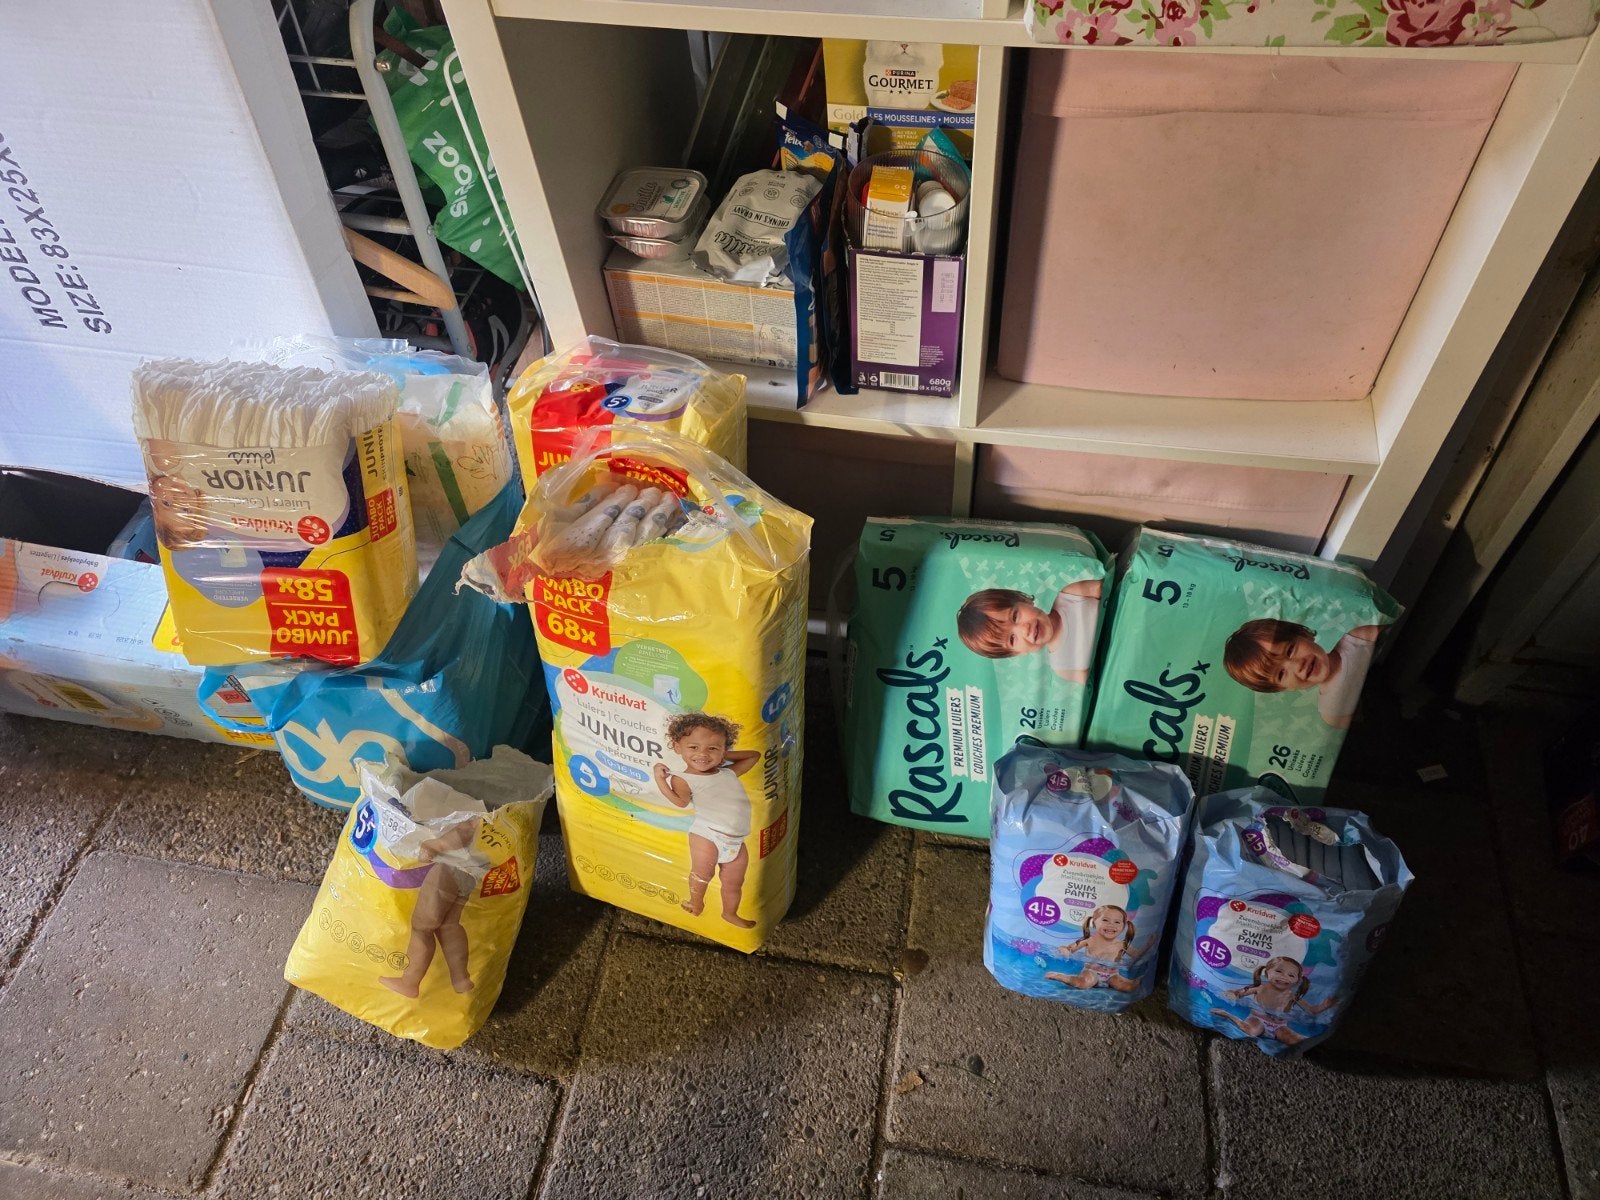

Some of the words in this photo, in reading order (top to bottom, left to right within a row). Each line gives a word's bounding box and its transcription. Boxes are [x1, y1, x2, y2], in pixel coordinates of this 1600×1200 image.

[868, 75, 933, 91] GOURMET
[833, 108, 864, 121] Gold
[885, 114, 936, 124] MOUSSELINES
[929, 378, 952, 387] 680g
[228, 447, 275, 470] plus
[201, 468, 312, 493] JUNIOR
[275, 498, 311, 510] Luiers
[376, 500, 386, 531] PACK
[231, 517, 294, 534] Kruidvat
[368, 498, 380, 539] JUMBO
[879, 529, 896, 542] 5
[943, 530, 1021, 549] Rascals
[1157, 544, 1174, 558] 5
[41, 568, 77, 582] Kruidvat
[872, 565, 907, 592] 5
[1229, 556, 1311, 581] Rascals
[276, 577, 332, 602] 58x
[543, 588, 593, 616] PACK
[1142, 577, 1182, 606] 5
[284, 609, 339, 626] PACK
[547, 612, 597, 647] 68x
[276, 626, 353, 645] JUMBO
[591, 684, 647, 712] Kruidvat
[576, 697, 606, 718] Luiers
[614, 714, 658, 735] Couches
[950, 695, 962, 730] LUIERS
[970, 694, 981, 735] PREMIUM
[1020, 706, 1038, 730] 26
[577, 711, 663, 760] JUNIOR
[876, 649, 969, 823] Rascals
[1196, 724, 1209, 756] LUIERS
[1215, 724, 1231, 768] PREMIUM
[954, 731, 965, 768] PREMIUM
[971, 736, 984, 775] COUCHES
[1268, 744, 1291, 769] 26
[579, 761, 597, 788] 5
[763, 744, 779, 801] JUNIOR
[1069, 860, 1097, 870] Kruidvat
[1064, 888, 1098, 900] PANTS
[1067, 881, 1096, 893] SWIM
[1247, 907, 1277, 920] Kruidvat
[1238, 934, 1273, 950] PANTS
[1242, 929, 1273, 942] SWIM
